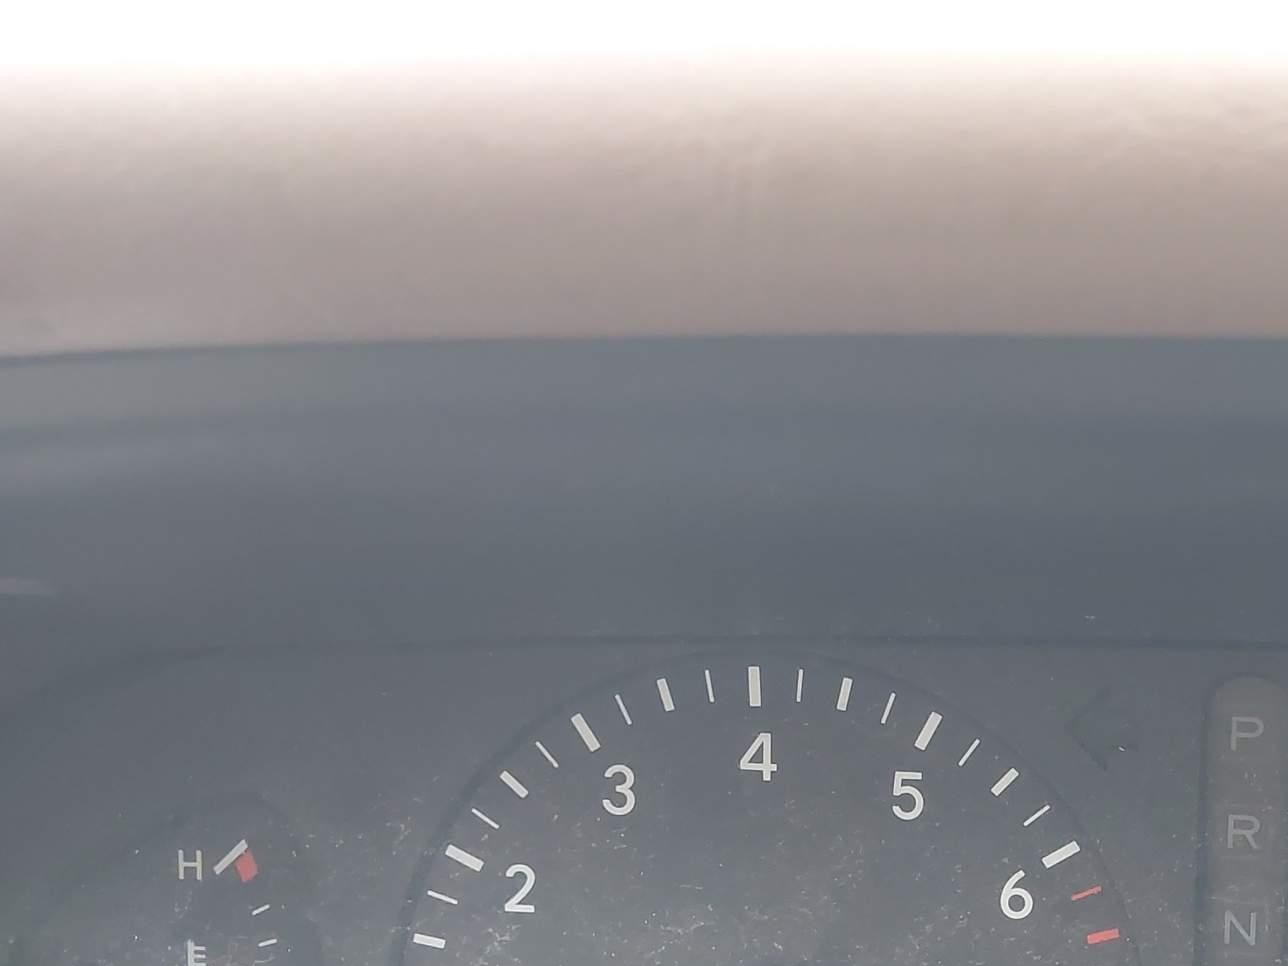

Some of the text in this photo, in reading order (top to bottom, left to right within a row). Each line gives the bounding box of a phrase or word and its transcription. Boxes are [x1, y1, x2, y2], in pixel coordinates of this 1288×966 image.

[739, 732, 777, 781] 4
[1229, 716, 1265, 751] P
[602, 764, 636, 815] 3
[892, 771, 924, 820] 5
[1226, 814, 1262, 849] R
[177, 850, 202, 881] H
[504, 864, 535, 913] 2
[1000, 870, 1034, 919] 6
[1223, 911, 1257, 946] N
